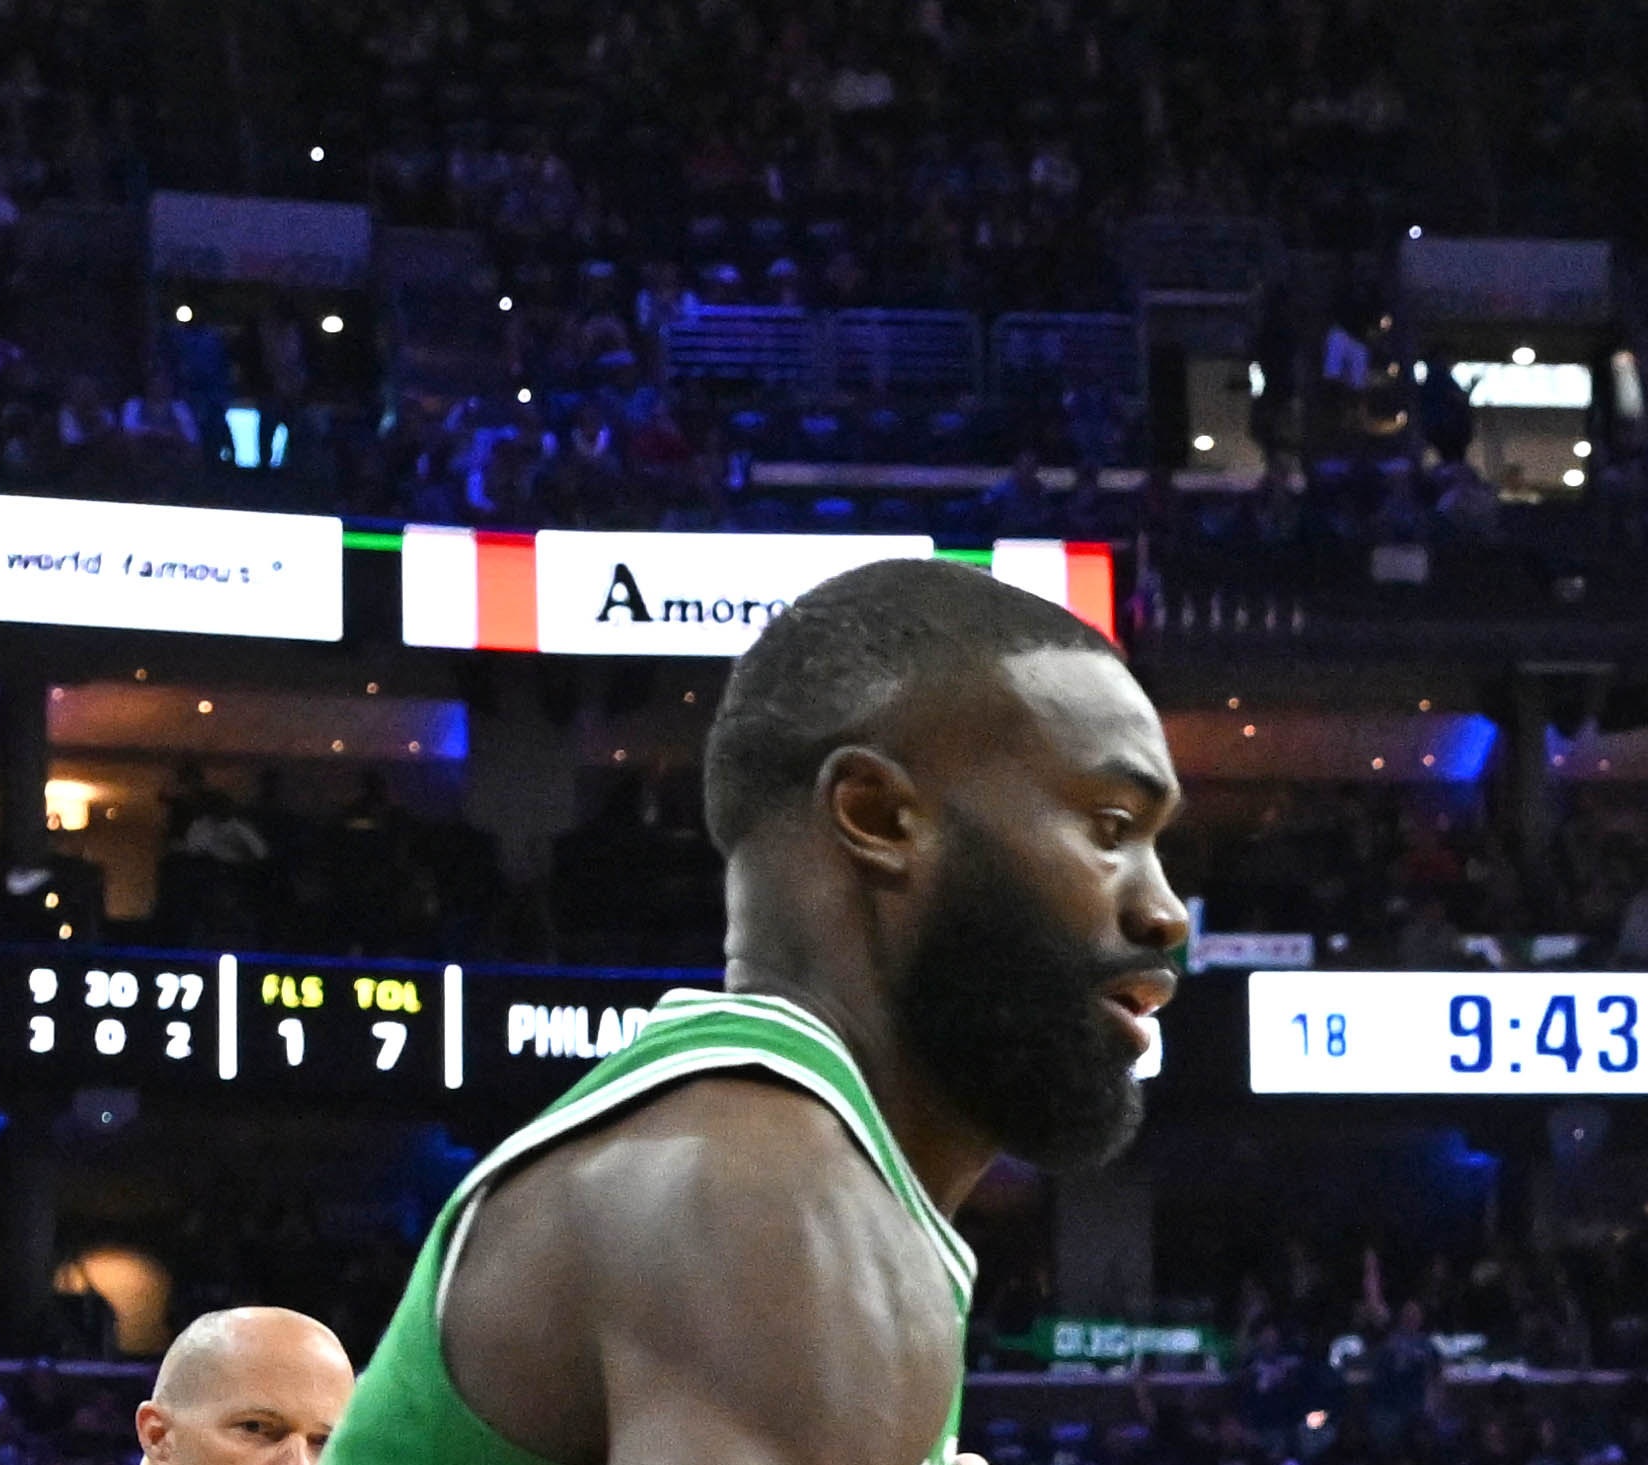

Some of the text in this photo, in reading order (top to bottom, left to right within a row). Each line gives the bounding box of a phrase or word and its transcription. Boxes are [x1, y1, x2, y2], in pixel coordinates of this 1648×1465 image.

[29, 969, 57, 1003] 9
[156, 973, 203, 1009] 77
[95, 1019, 126, 1054] 0
[278, 1019, 406, 1070] 1 7
[1291, 1012, 1347, 1058] 18
[1448, 994, 1639, 1073] 9:43
